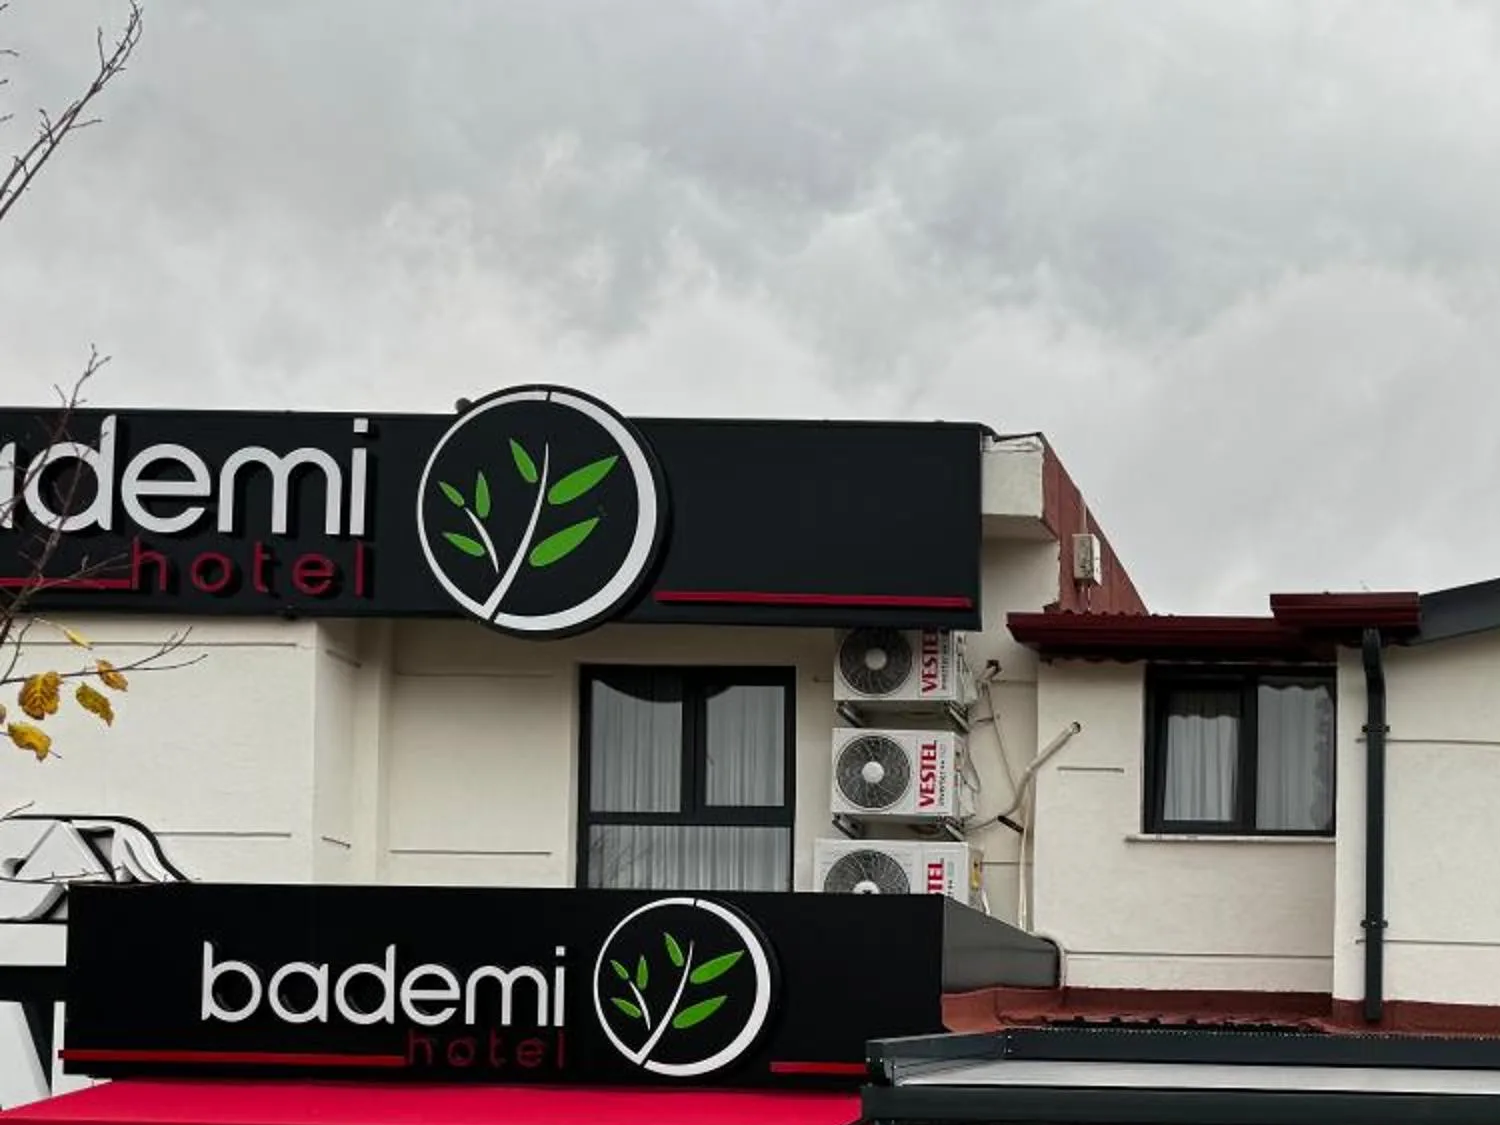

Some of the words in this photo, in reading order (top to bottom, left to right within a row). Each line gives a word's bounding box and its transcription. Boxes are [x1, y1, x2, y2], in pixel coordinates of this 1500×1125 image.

[0, 415, 369, 536] demi
[131, 537, 366, 598] hotel
[919, 740, 938, 807] VESTEL
[927, 858, 943, 895] TEL
[202, 940, 565, 1027] bademi
[408, 1028, 565, 1069] hotel
